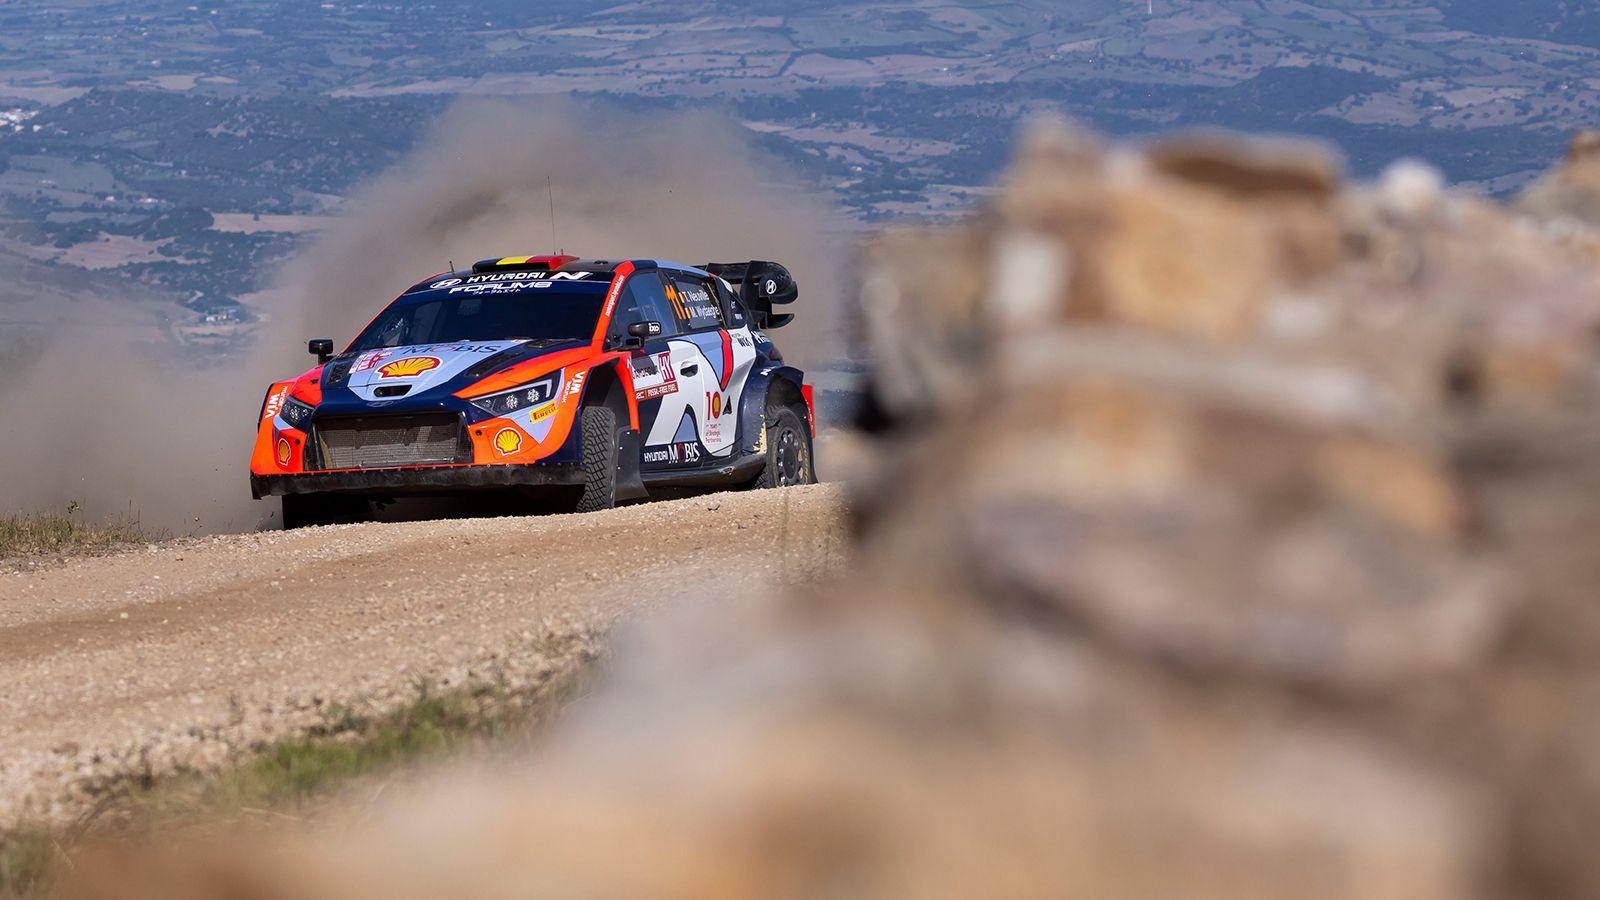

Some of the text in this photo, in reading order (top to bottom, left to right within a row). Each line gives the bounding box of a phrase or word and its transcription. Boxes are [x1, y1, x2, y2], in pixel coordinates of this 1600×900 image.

[466, 272, 546, 283] HYUNDAI
[449, 281, 553, 294] FORUM8
[687, 289, 710, 302] Neuville
[665, 284, 687, 320] 11
[659, 355, 674, 380] HY
[644, 441, 700, 464] HYUNDAI MOBIS
